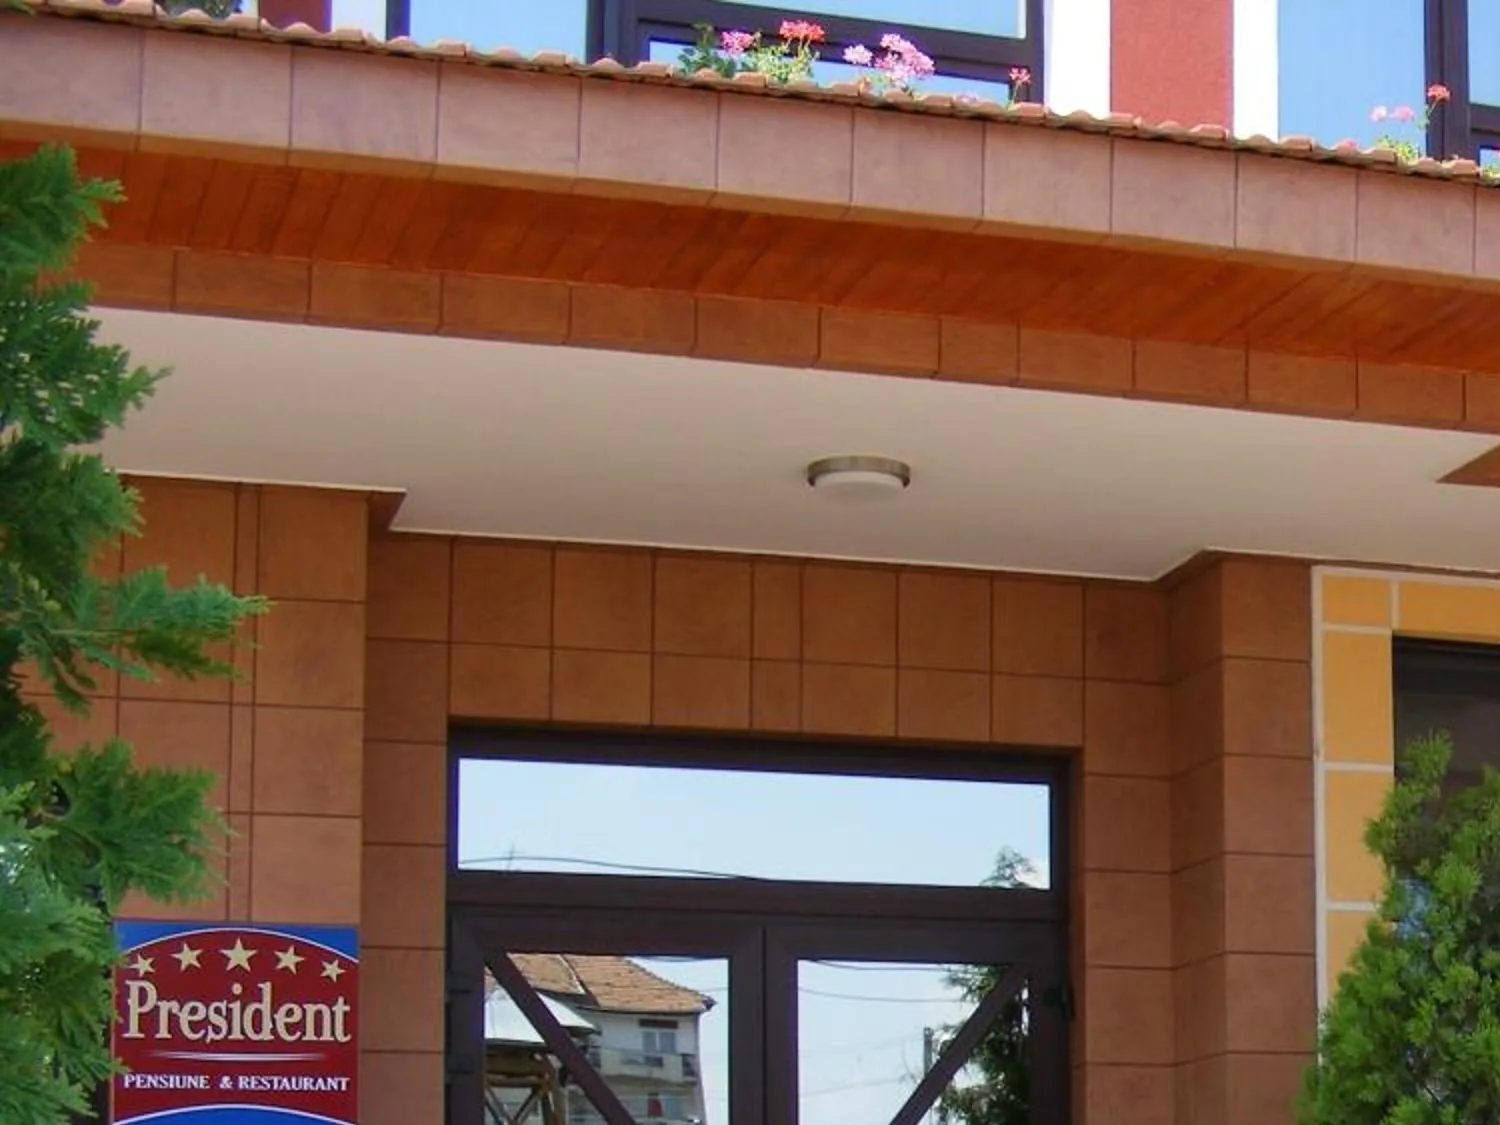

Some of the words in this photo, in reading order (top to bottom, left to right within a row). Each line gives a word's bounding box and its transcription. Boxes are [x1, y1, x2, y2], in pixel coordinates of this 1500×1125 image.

[122, 979, 352, 1044] President
[122, 1073, 211, 1090] PENSIUNE
[219, 1074, 233, 1090] &
[238, 1074, 350, 1093] RESTAURANT
